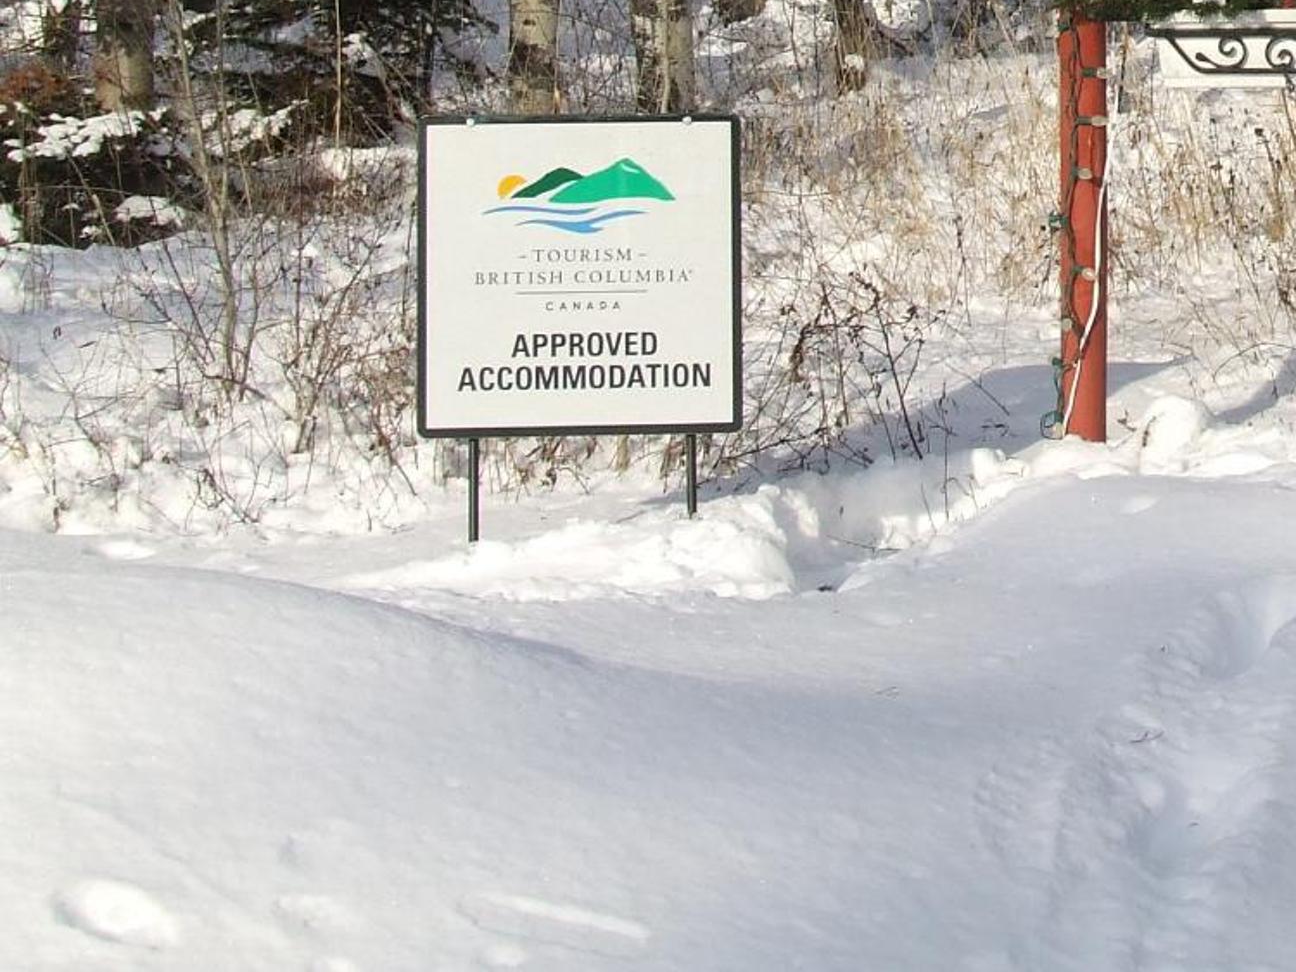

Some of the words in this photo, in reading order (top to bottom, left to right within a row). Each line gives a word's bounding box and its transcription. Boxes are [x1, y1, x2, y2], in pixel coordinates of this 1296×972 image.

[532, 248, 632, 263] TOURISM
[474, 271, 563, 286] BRITISH
[573, 268, 692, 284] COLUMBIA
[545, 300, 622, 312] CANADA
[511, 332, 658, 358] APPROVED
[457, 363, 711, 392] ACCOMMODATION
